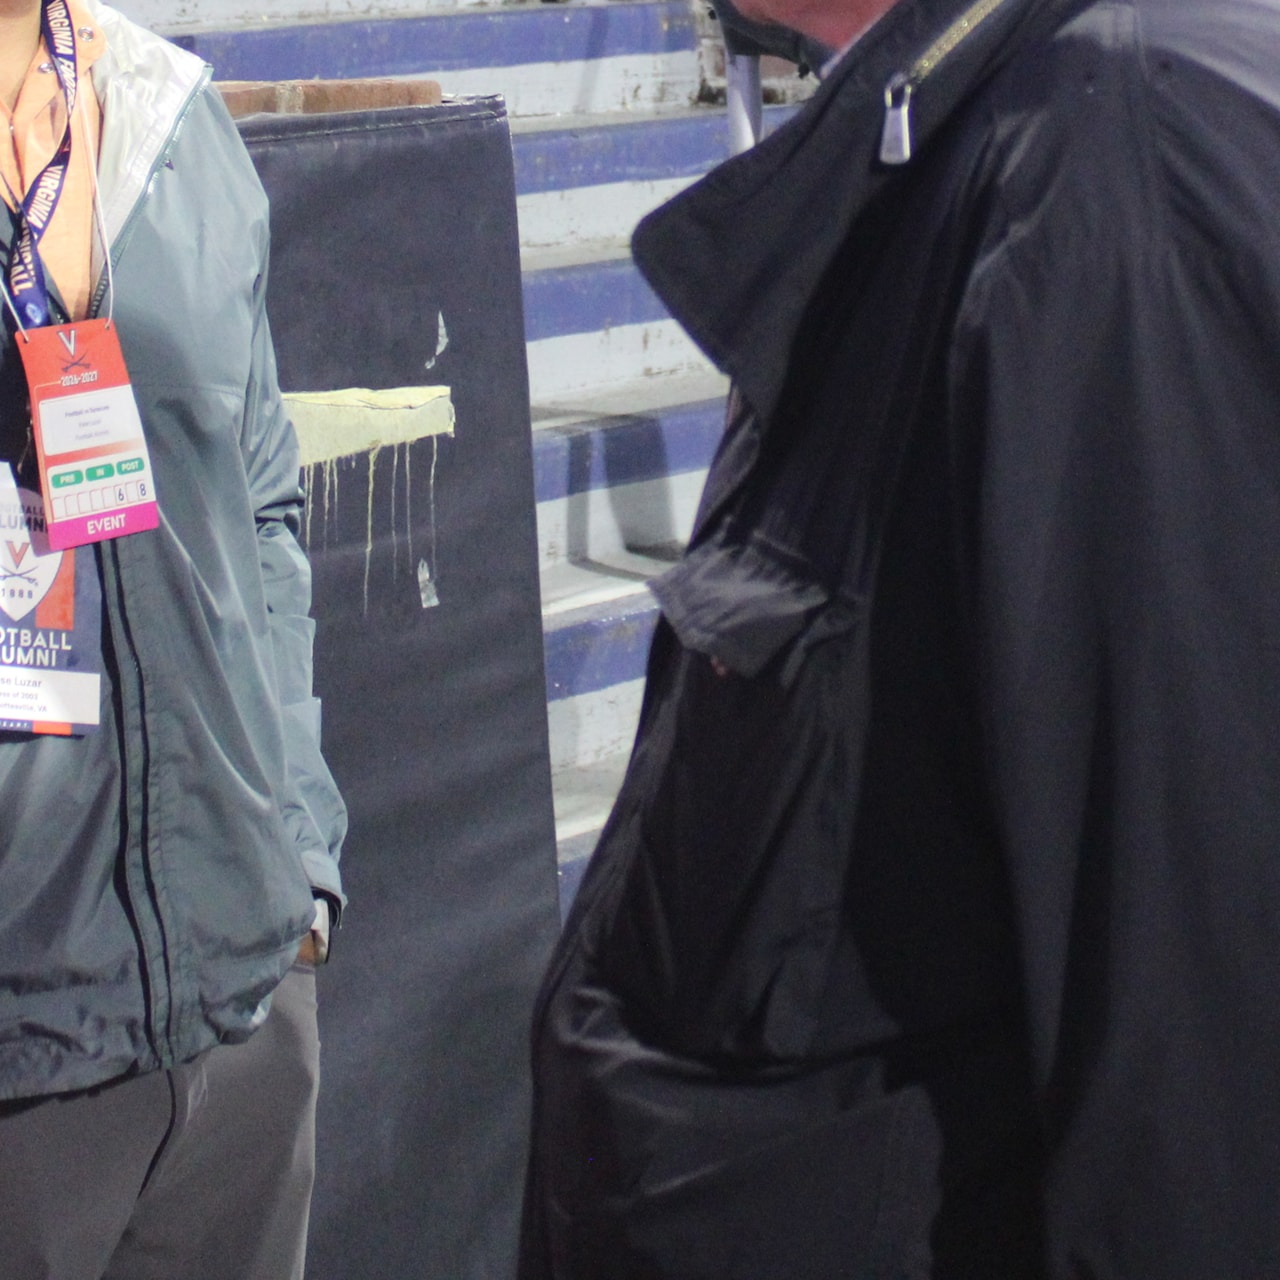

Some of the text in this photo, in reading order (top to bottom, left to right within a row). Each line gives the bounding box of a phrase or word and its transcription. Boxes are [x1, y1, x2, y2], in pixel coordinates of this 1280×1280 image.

[26, 165, 65, 229] VIRGINIA
[122, 461, 139, 472] POST
[87, 514, 126, 535] EVENT
